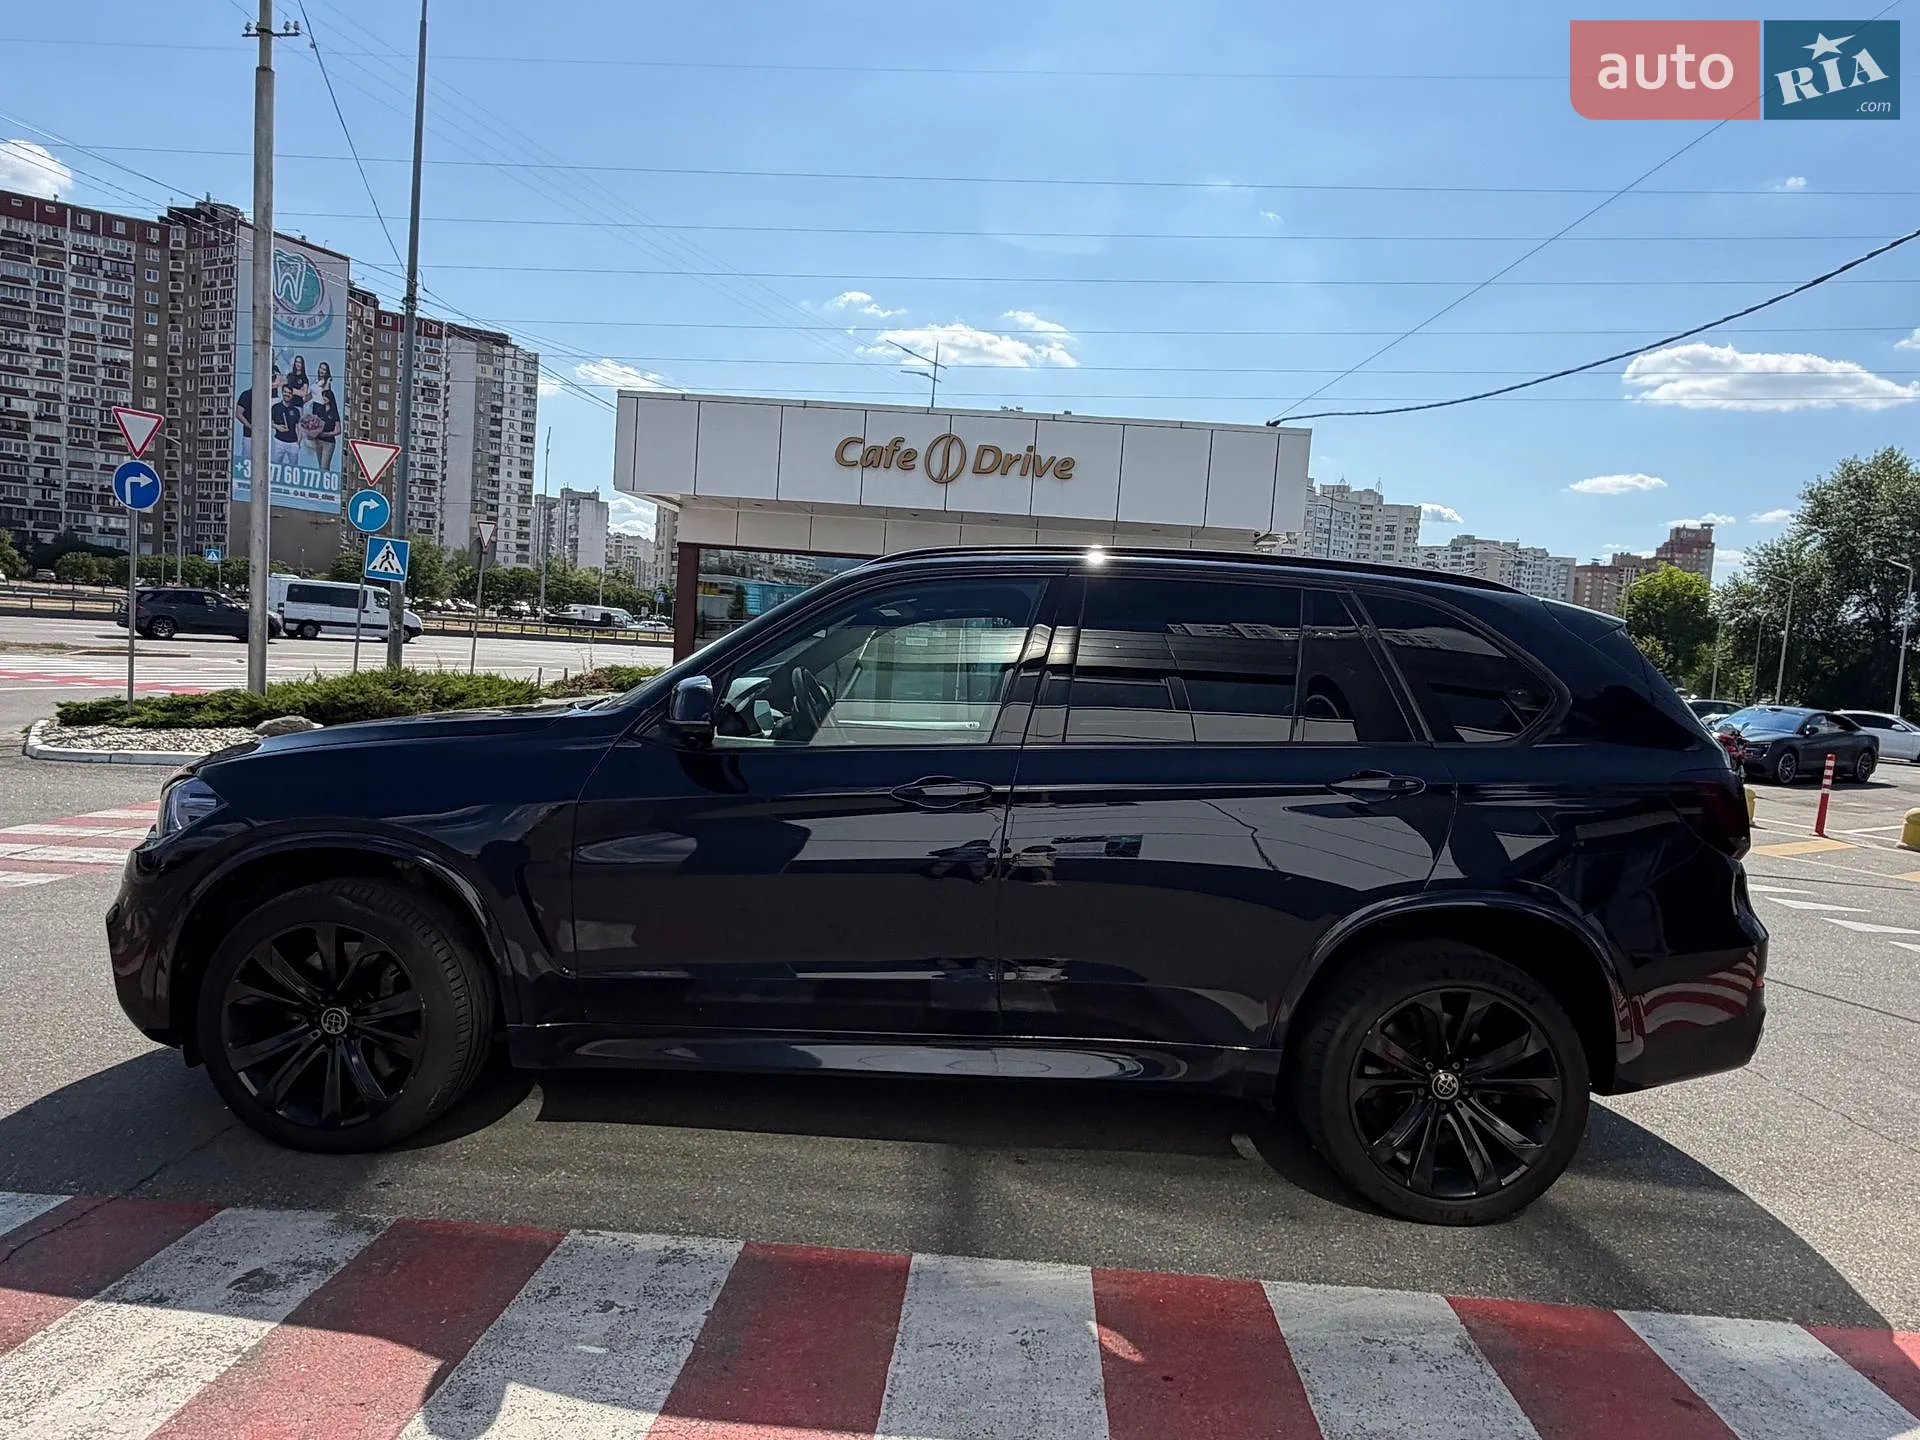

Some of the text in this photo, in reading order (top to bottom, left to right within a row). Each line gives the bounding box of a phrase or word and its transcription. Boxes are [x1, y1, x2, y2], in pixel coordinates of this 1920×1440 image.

[234, 459, 251, 478] +3
[284, 465, 300, 485] 60
[303, 468, 321, 489] 777
[323, 471, 339, 491] 60
[834, 436, 1076, 480] Cafe Drive
